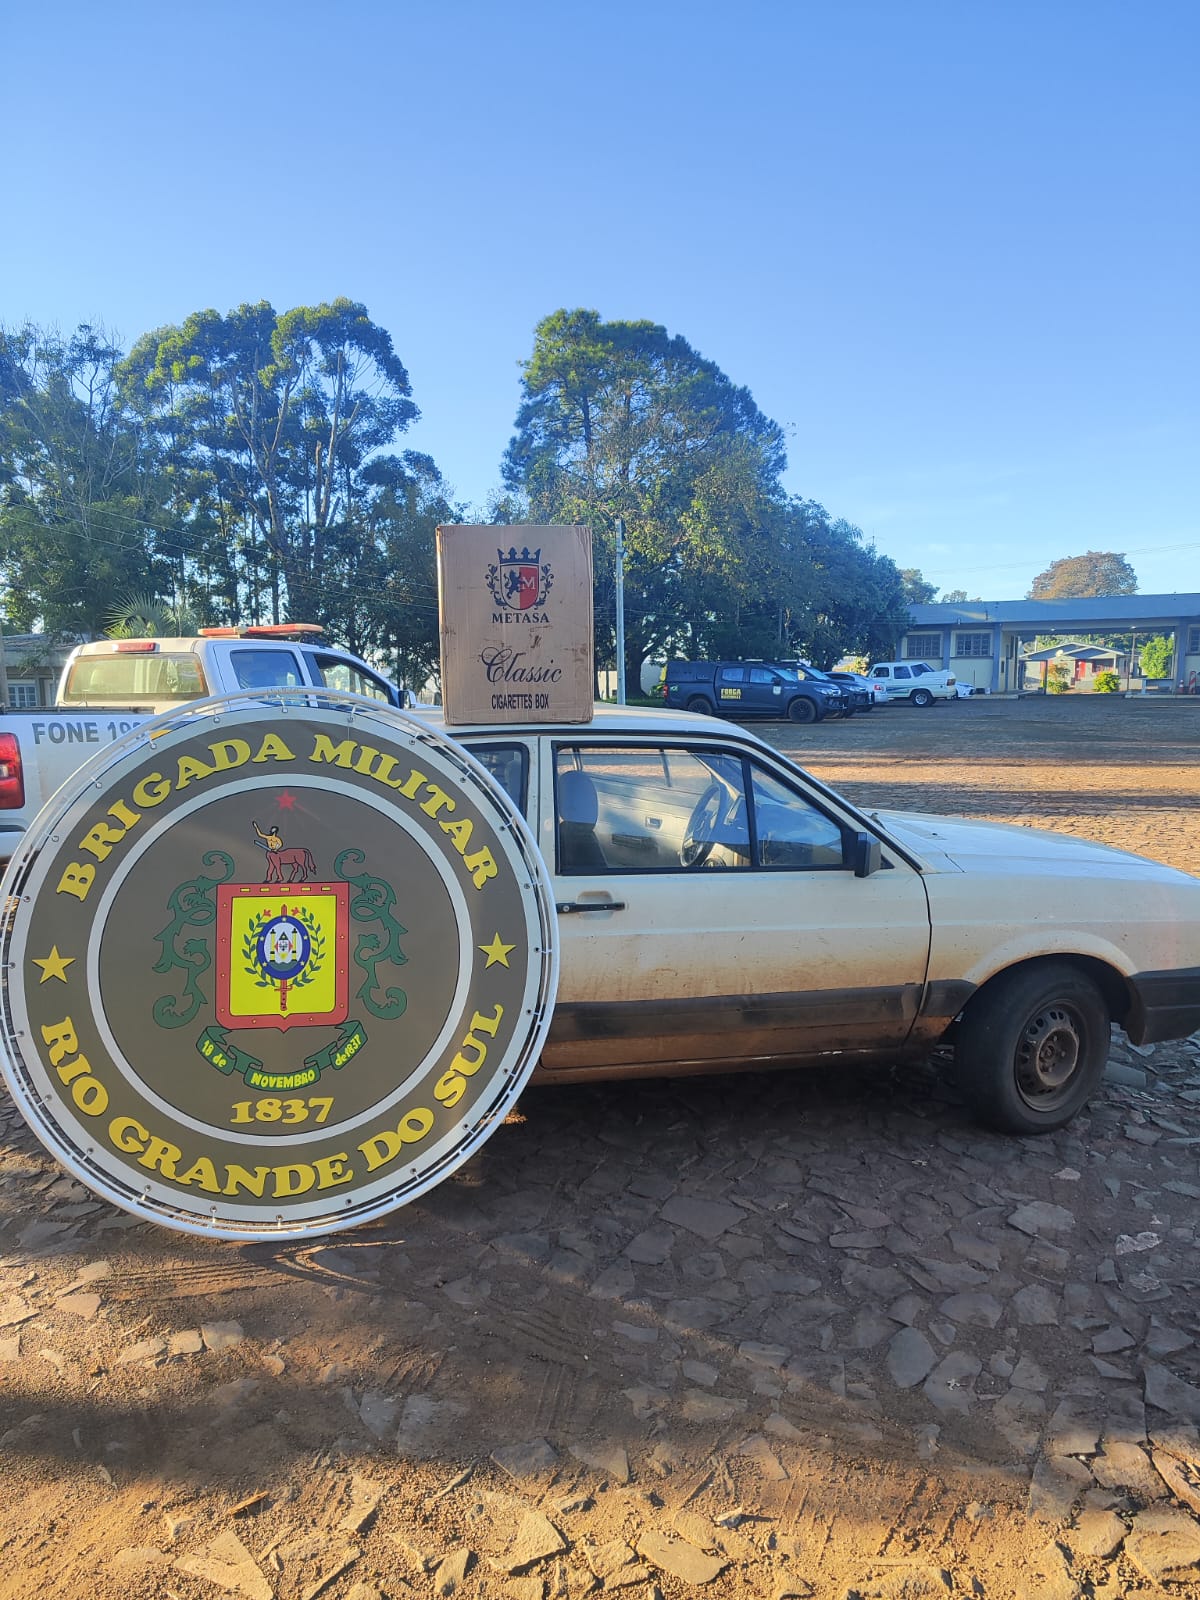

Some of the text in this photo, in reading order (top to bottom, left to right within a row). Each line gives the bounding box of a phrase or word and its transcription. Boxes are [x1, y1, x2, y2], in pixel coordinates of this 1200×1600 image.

[492, 612, 550, 624] METASA
[481, 646, 563, 684] Classic
[491, 693, 550, 710] CIGARETTES BOX
[31, 721, 141, 745] FONE 19
[56, 733, 499, 902] BRIGADA MILITAR
[212, 1052, 227, 1068] de
[250, 1069, 316, 1089] NOVEMBRO
[41, 1003, 504, 1199] RIO GRANDE DO SUL
[230, 1097, 335, 1124] 1837
